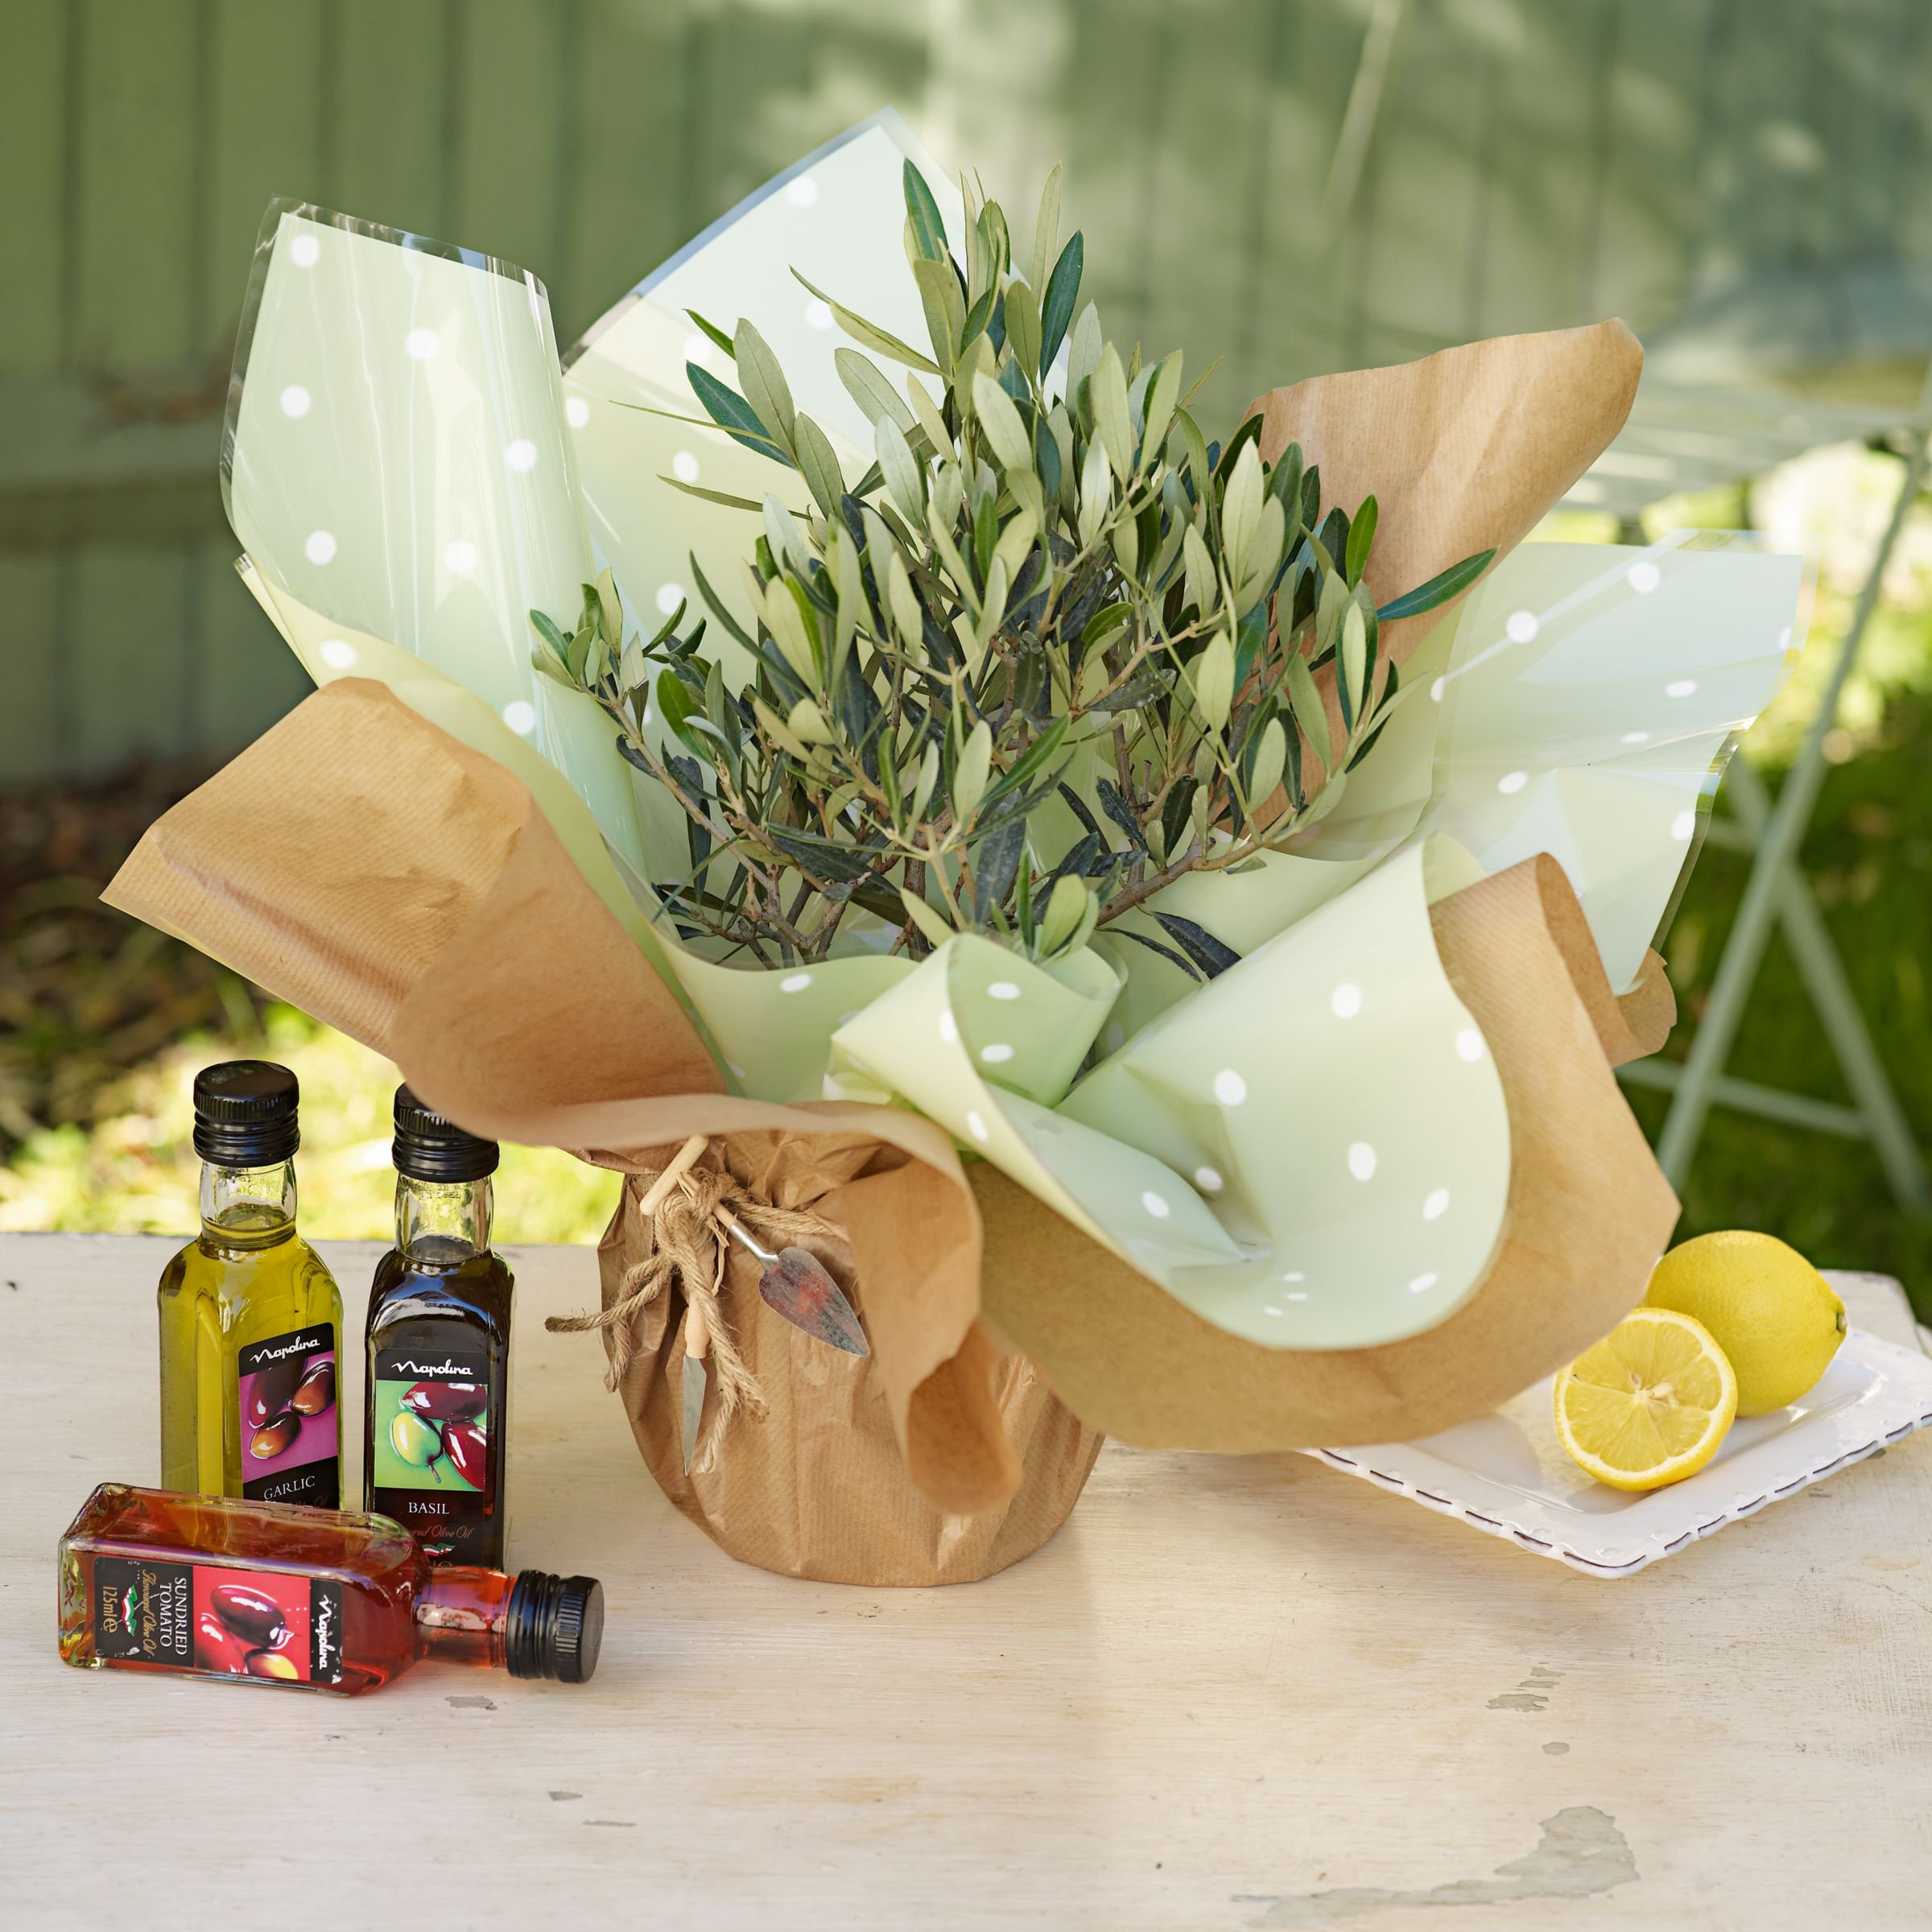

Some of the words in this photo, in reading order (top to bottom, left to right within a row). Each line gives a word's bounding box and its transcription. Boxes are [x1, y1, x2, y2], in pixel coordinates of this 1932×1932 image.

[249, 1335, 320, 1364] Napolina
[390, 1358, 474, 1377] Napolina
[263, 1476, 316, 1501] GARLIC
[408, 1501, 451, 1515] BASIL
[431, 1524, 456, 1538] Olive
[456, 1525, 476, 1539] Oil
[142, 1569, 156, 1617] Flavoured
[142, 1615, 157, 1638] Olive
[159, 1583, 172, 1648] TOMATO
[174, 1577, 188, 1656] SUNDRIED
[314, 1594, 336, 1670] Napolina
[142, 1639, 157, 1657] Oil
